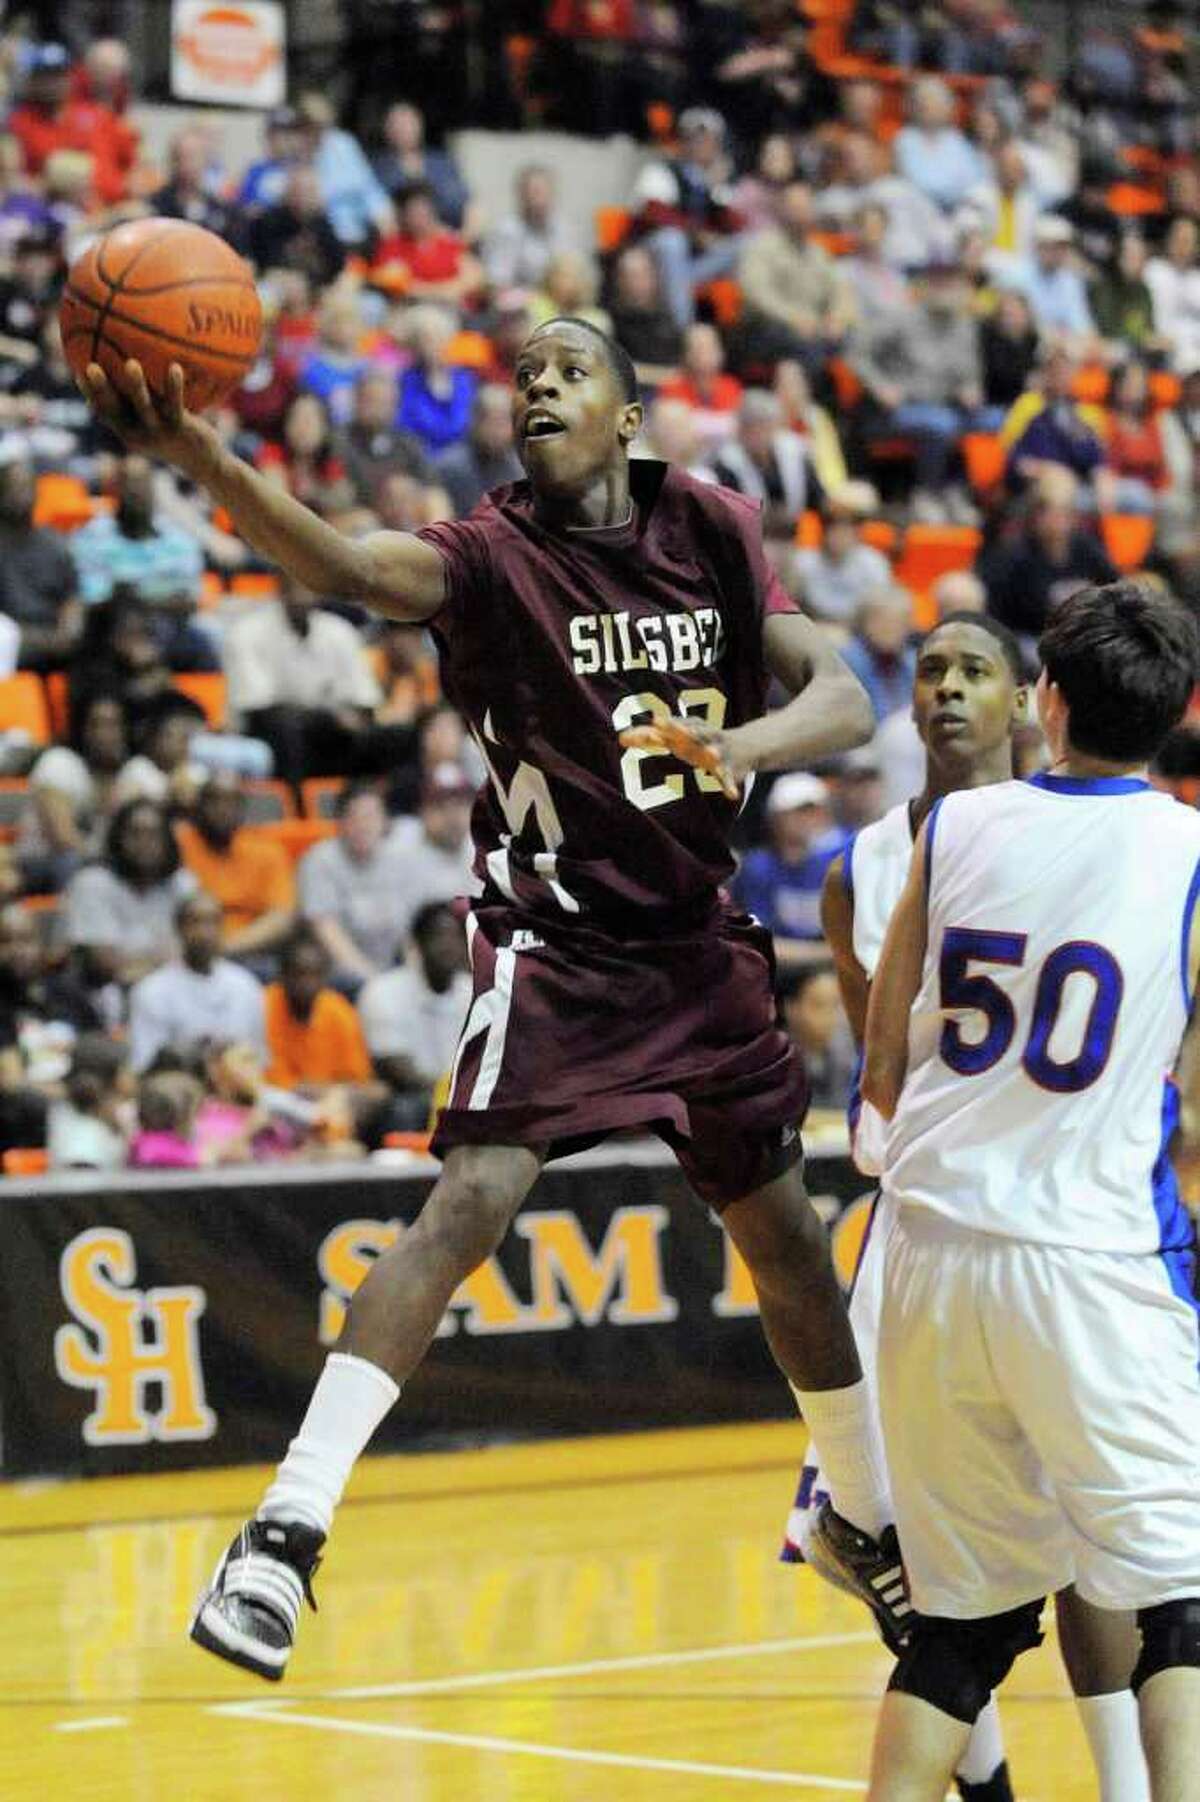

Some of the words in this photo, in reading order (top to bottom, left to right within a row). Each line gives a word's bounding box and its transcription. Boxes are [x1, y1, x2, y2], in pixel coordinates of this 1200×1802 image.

[569, 608, 722, 675] SILSBE
[939, 926, 1124, 1093] 50
[54, 1226, 217, 1446] SH
